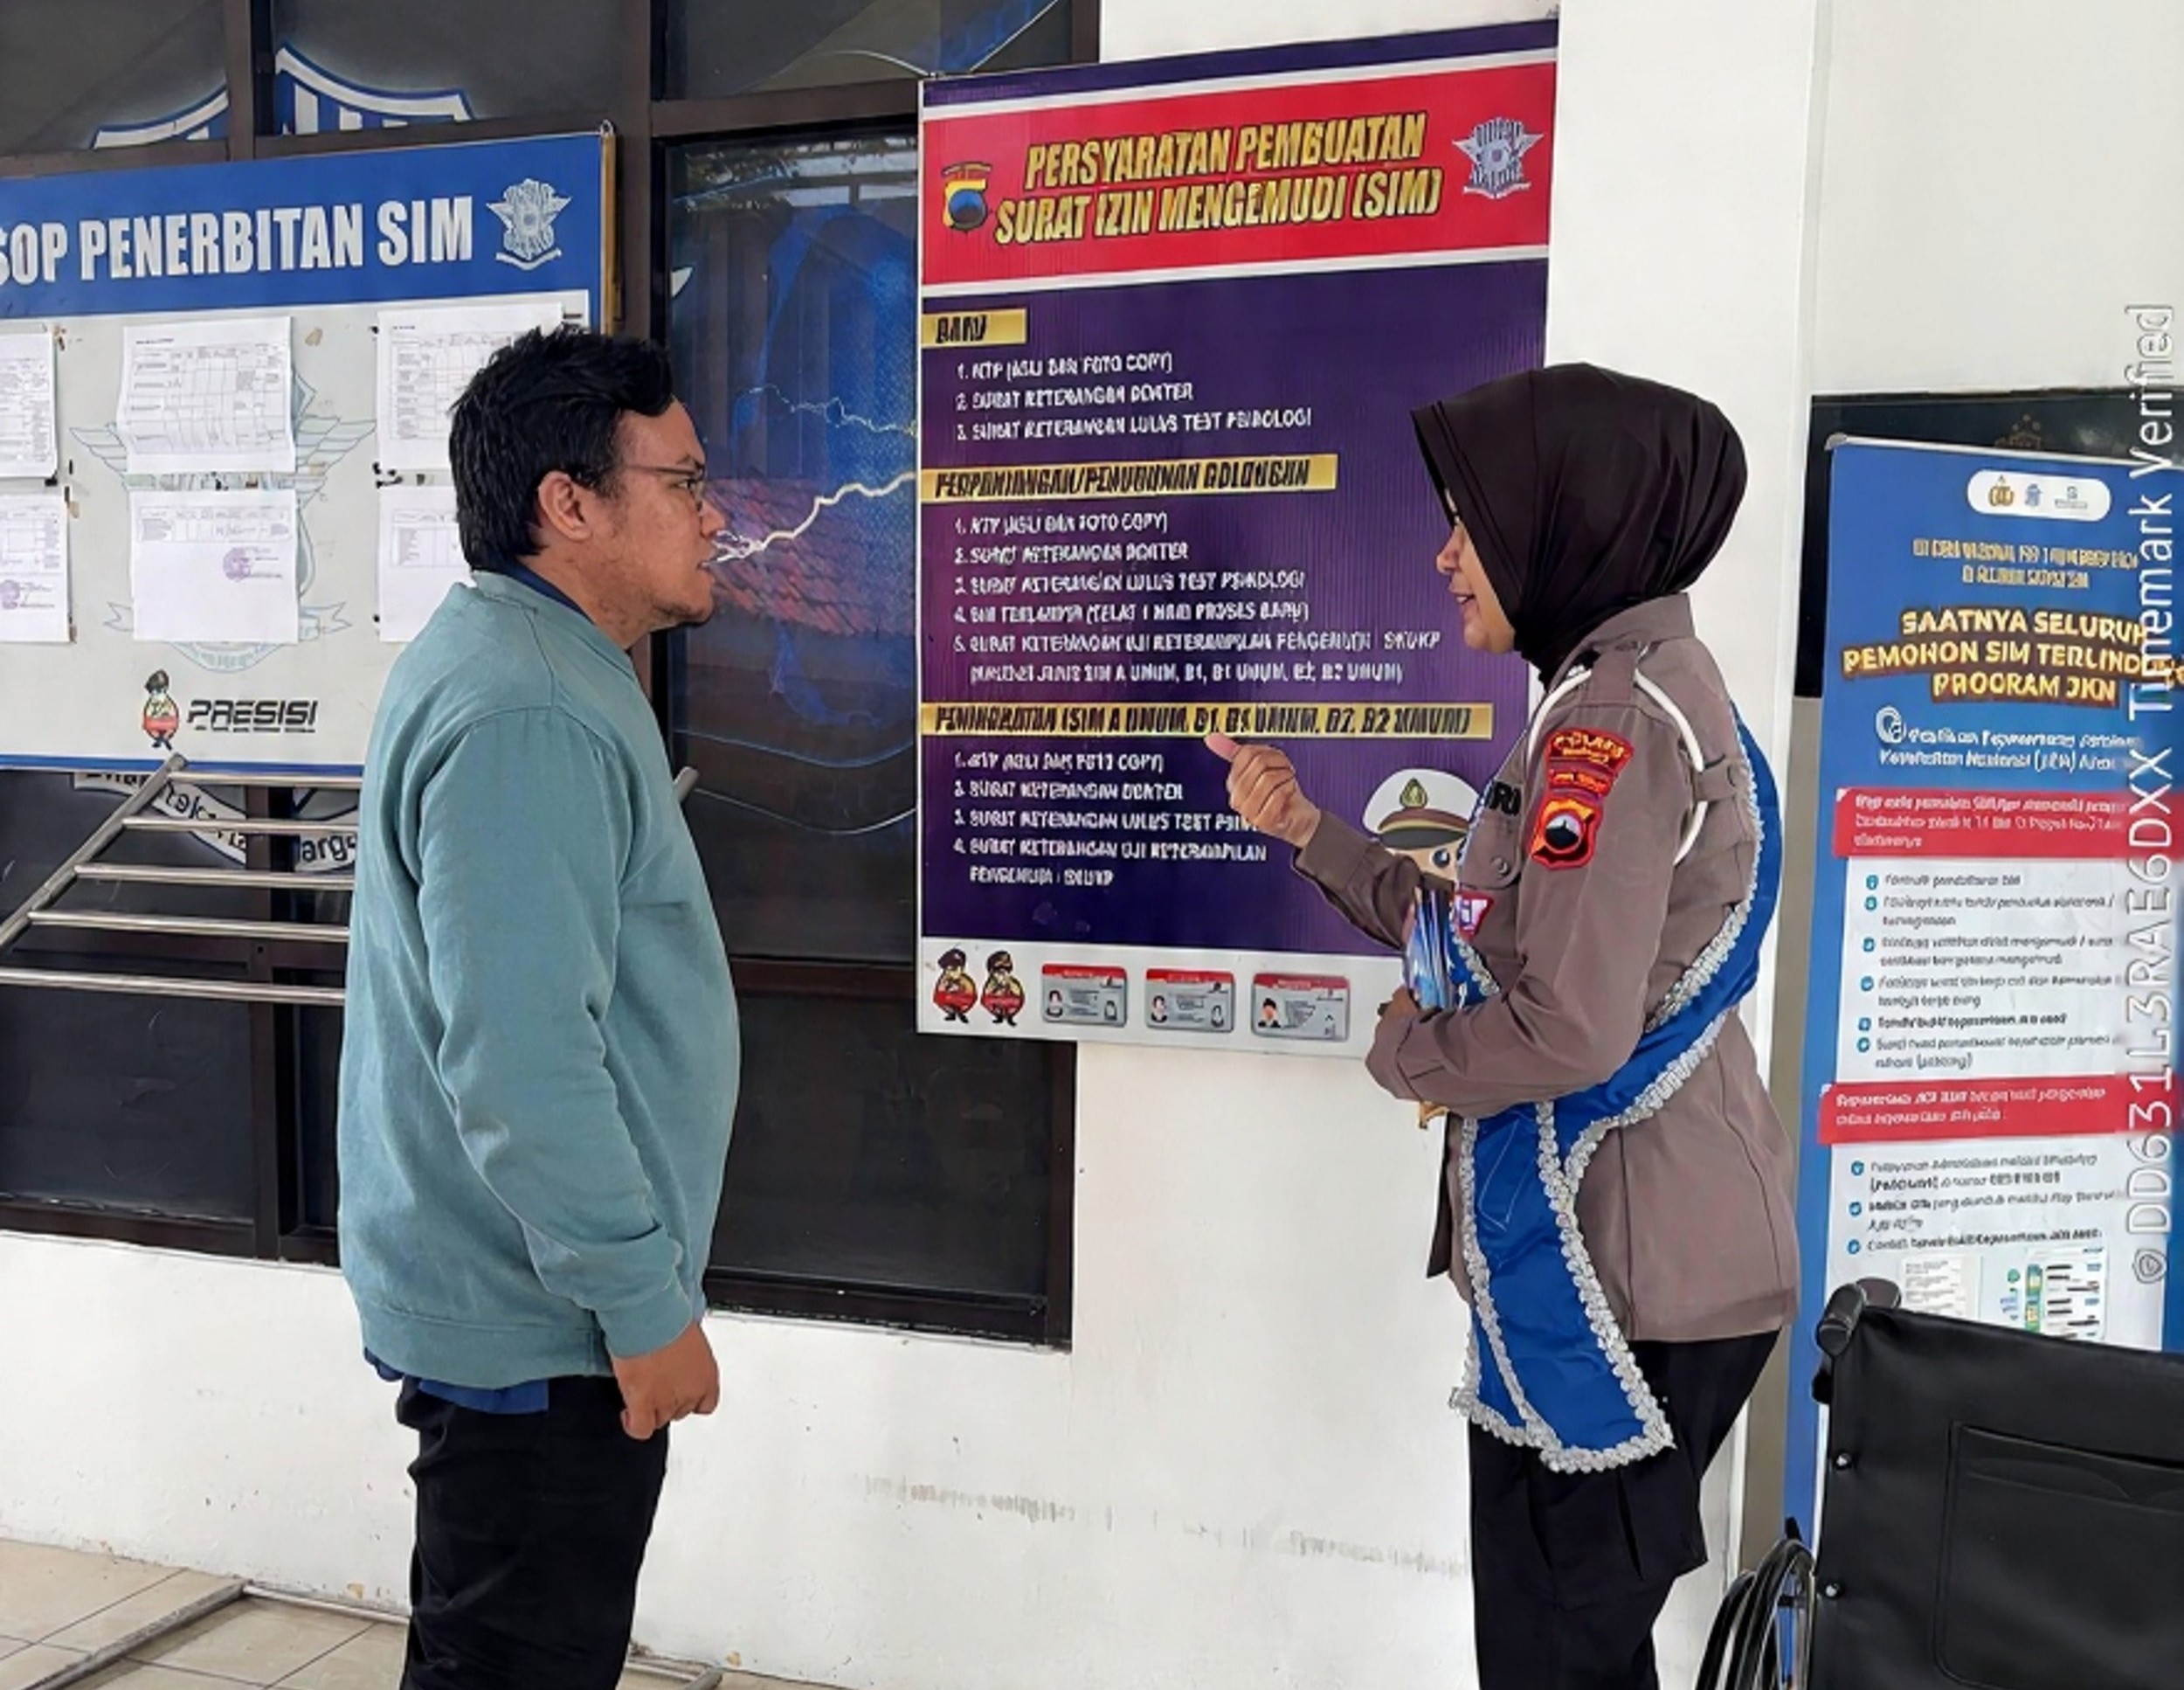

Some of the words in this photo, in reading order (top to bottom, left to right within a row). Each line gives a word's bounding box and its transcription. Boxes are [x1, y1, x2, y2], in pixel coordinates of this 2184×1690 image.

[1026, 128, 1230, 190] PERSYARATAN
[1235, 113, 1428, 171] PEMBUATAN
[994, 195, 1090, 246] SURAT
[1093, 190, 1151, 239] IZIN
[1158, 177, 1350, 232] MENGEMUDI
[1351, 167, 1443, 222] (SIM)
[80, 204, 363, 281] PENERBITAN
[377, 195, 473, 267] SIM
[1901, 608, 2028, 636] SAATNYA
[1842, 640, 1979, 672] PEMOHON
[1984, 641, 2030, 664] SIM
[1932, 672, 2061, 696] PROGRAM
[2064, 676, 2117, 703] JKN
[188, 698, 319, 725] PRESISI
